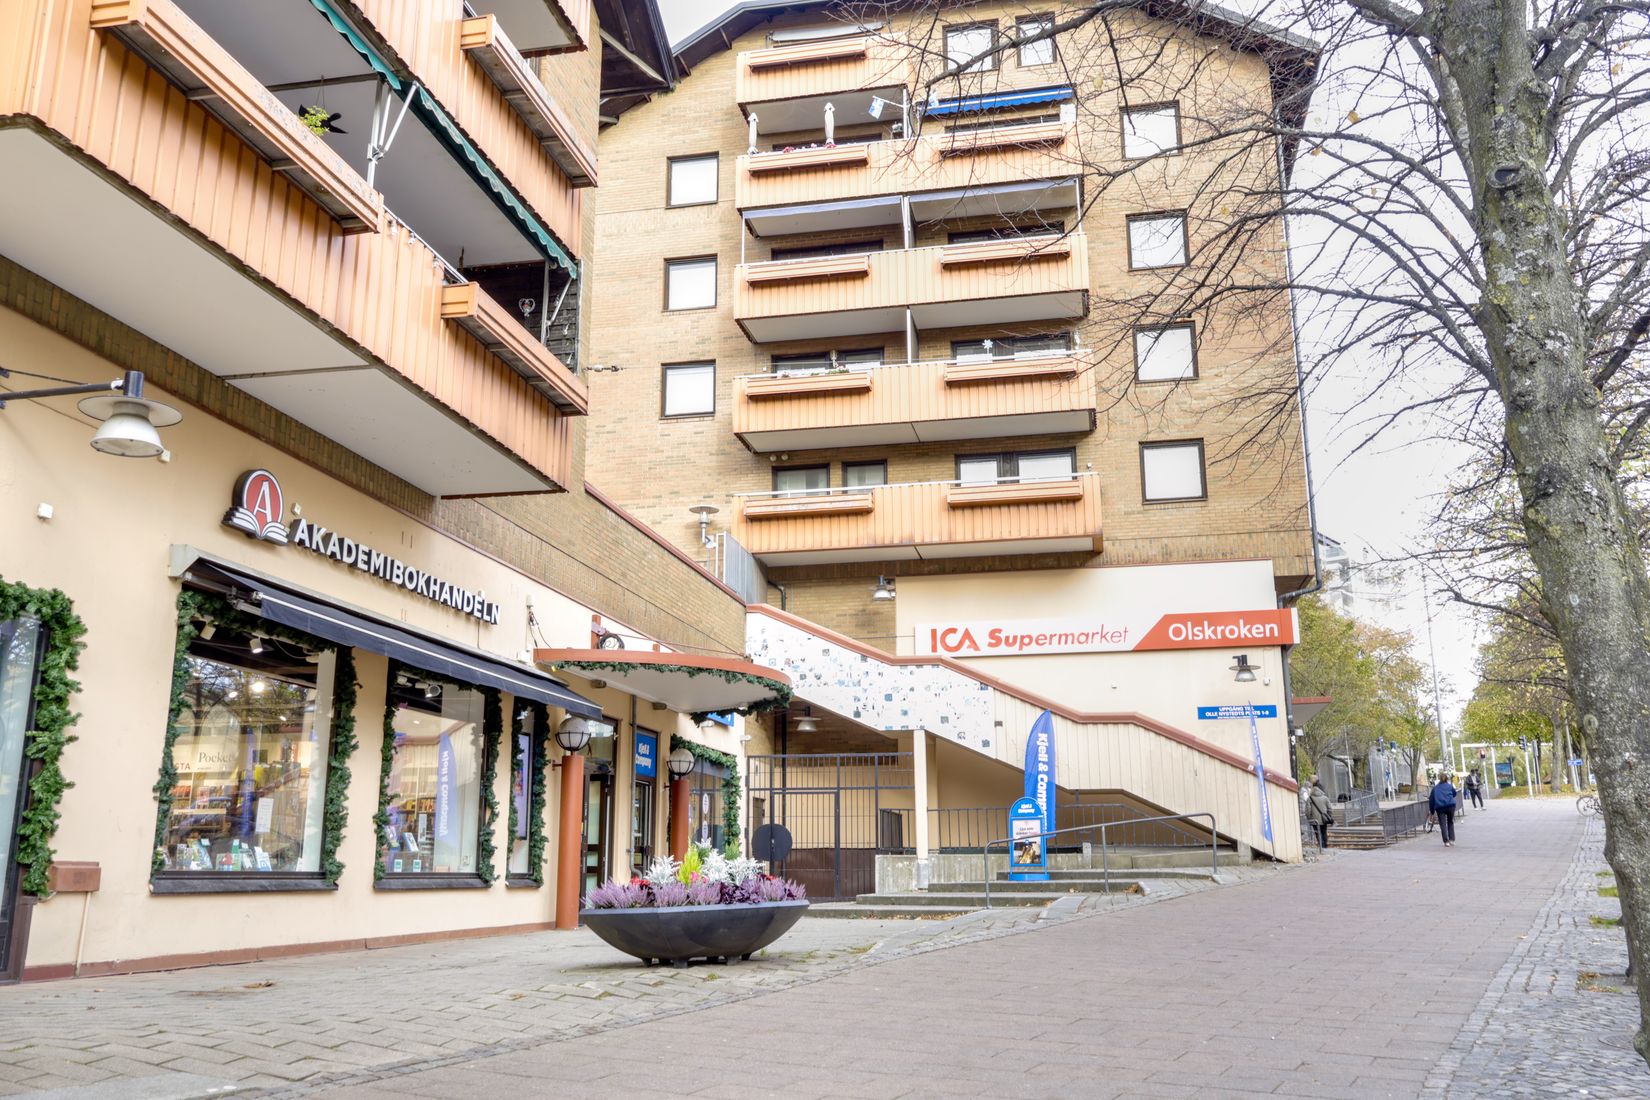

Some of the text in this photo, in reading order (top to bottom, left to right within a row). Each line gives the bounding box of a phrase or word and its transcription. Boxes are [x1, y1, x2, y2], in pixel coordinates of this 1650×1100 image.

[293, 518, 501, 625] AKADEMIBOKHANDELN
[930, 619, 1279, 653] ICA Supermarket Olskroken
[1037, 733, 1049, 762] Kjell
[1037, 762, 1049, 772] &
